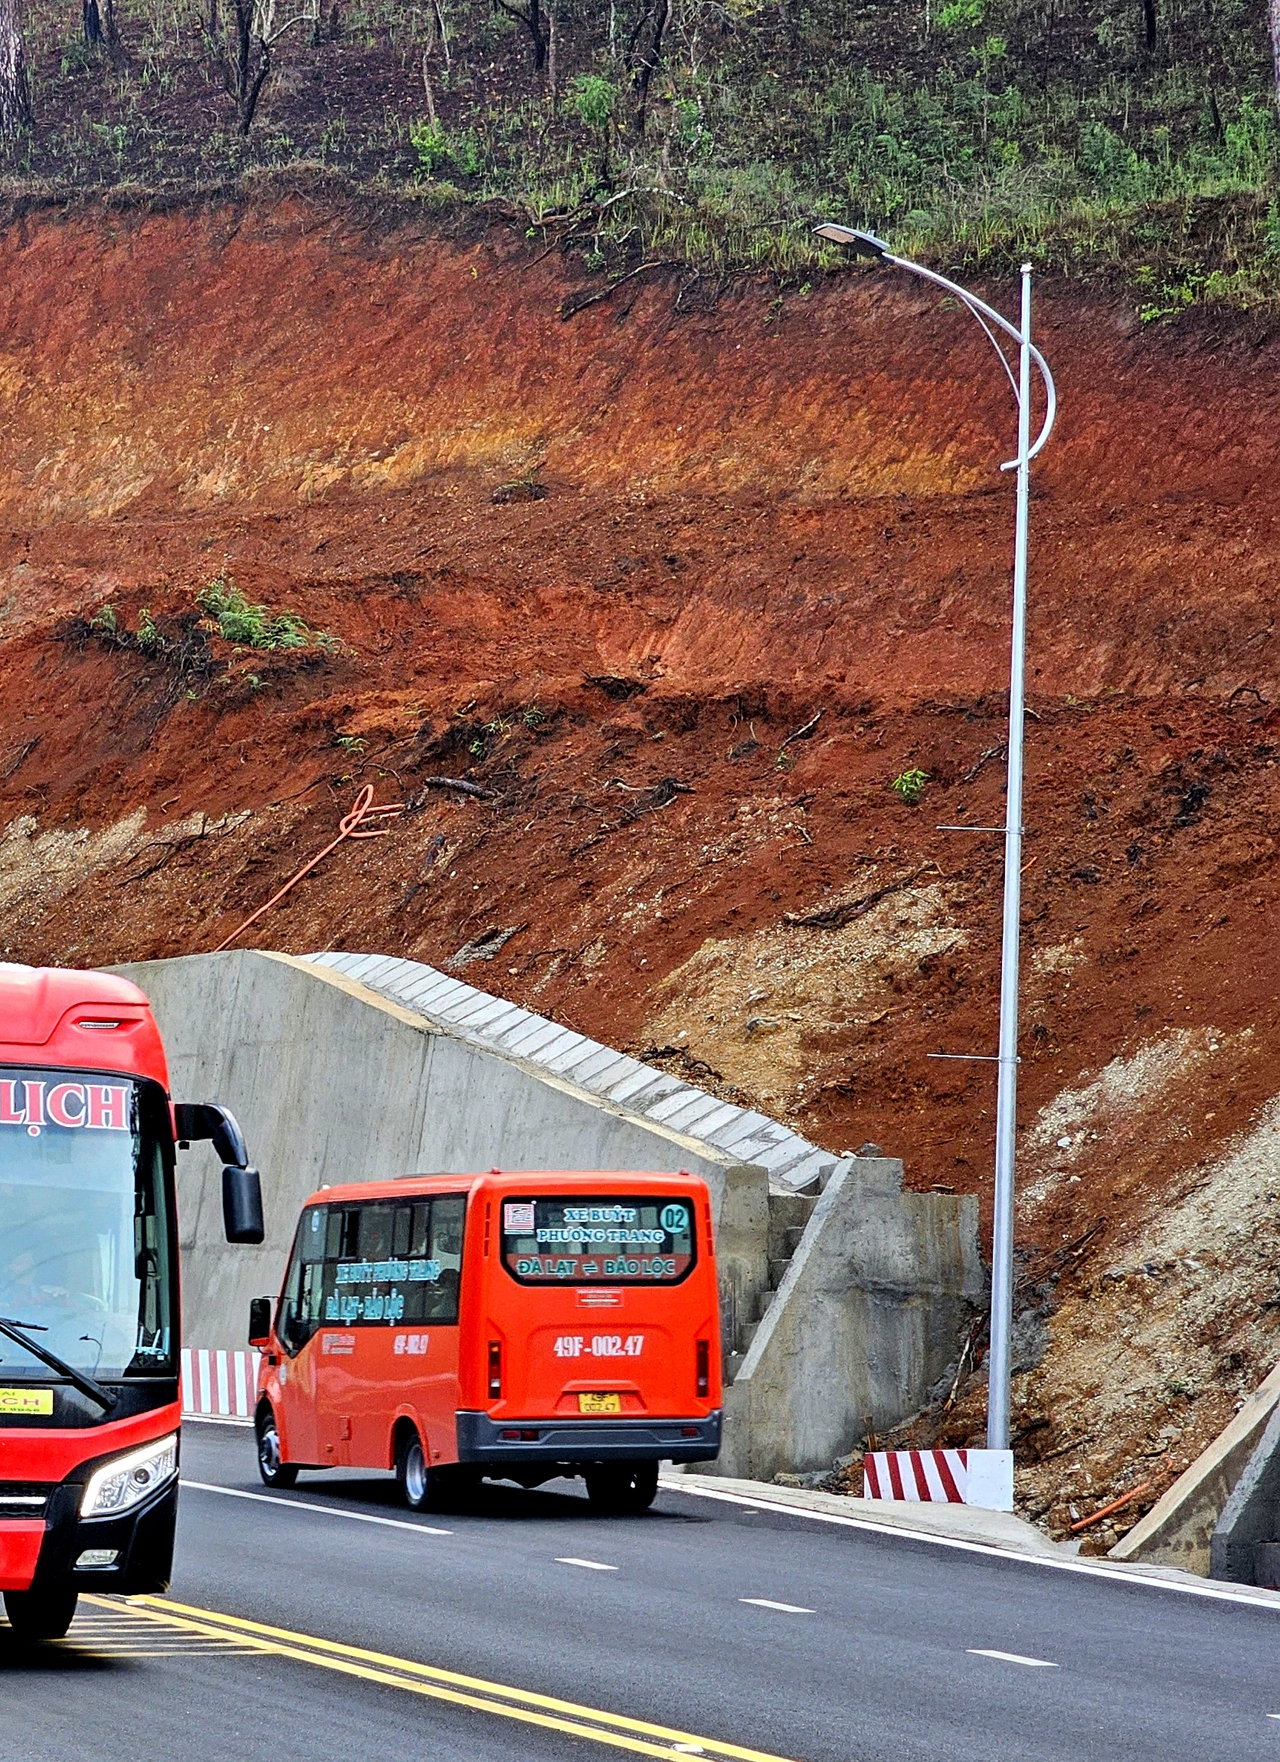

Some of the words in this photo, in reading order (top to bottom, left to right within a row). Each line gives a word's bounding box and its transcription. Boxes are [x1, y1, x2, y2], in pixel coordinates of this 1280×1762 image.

[564, 1208, 588, 1222] XE
[590, 1205, 636, 1222] BUÝT
[665, 1208, 684, 1229] 02
[607, 1229, 665, 1243] TRANG
[517, 1256, 543, 1275] ĐÀ
[546, 1259, 577, 1279] LẠT
[604, 1256, 639, 1275] BẢO
[642, 1257, 676, 1278] LỘC
[553, 1335, 644, 1357] 49F-002.47
